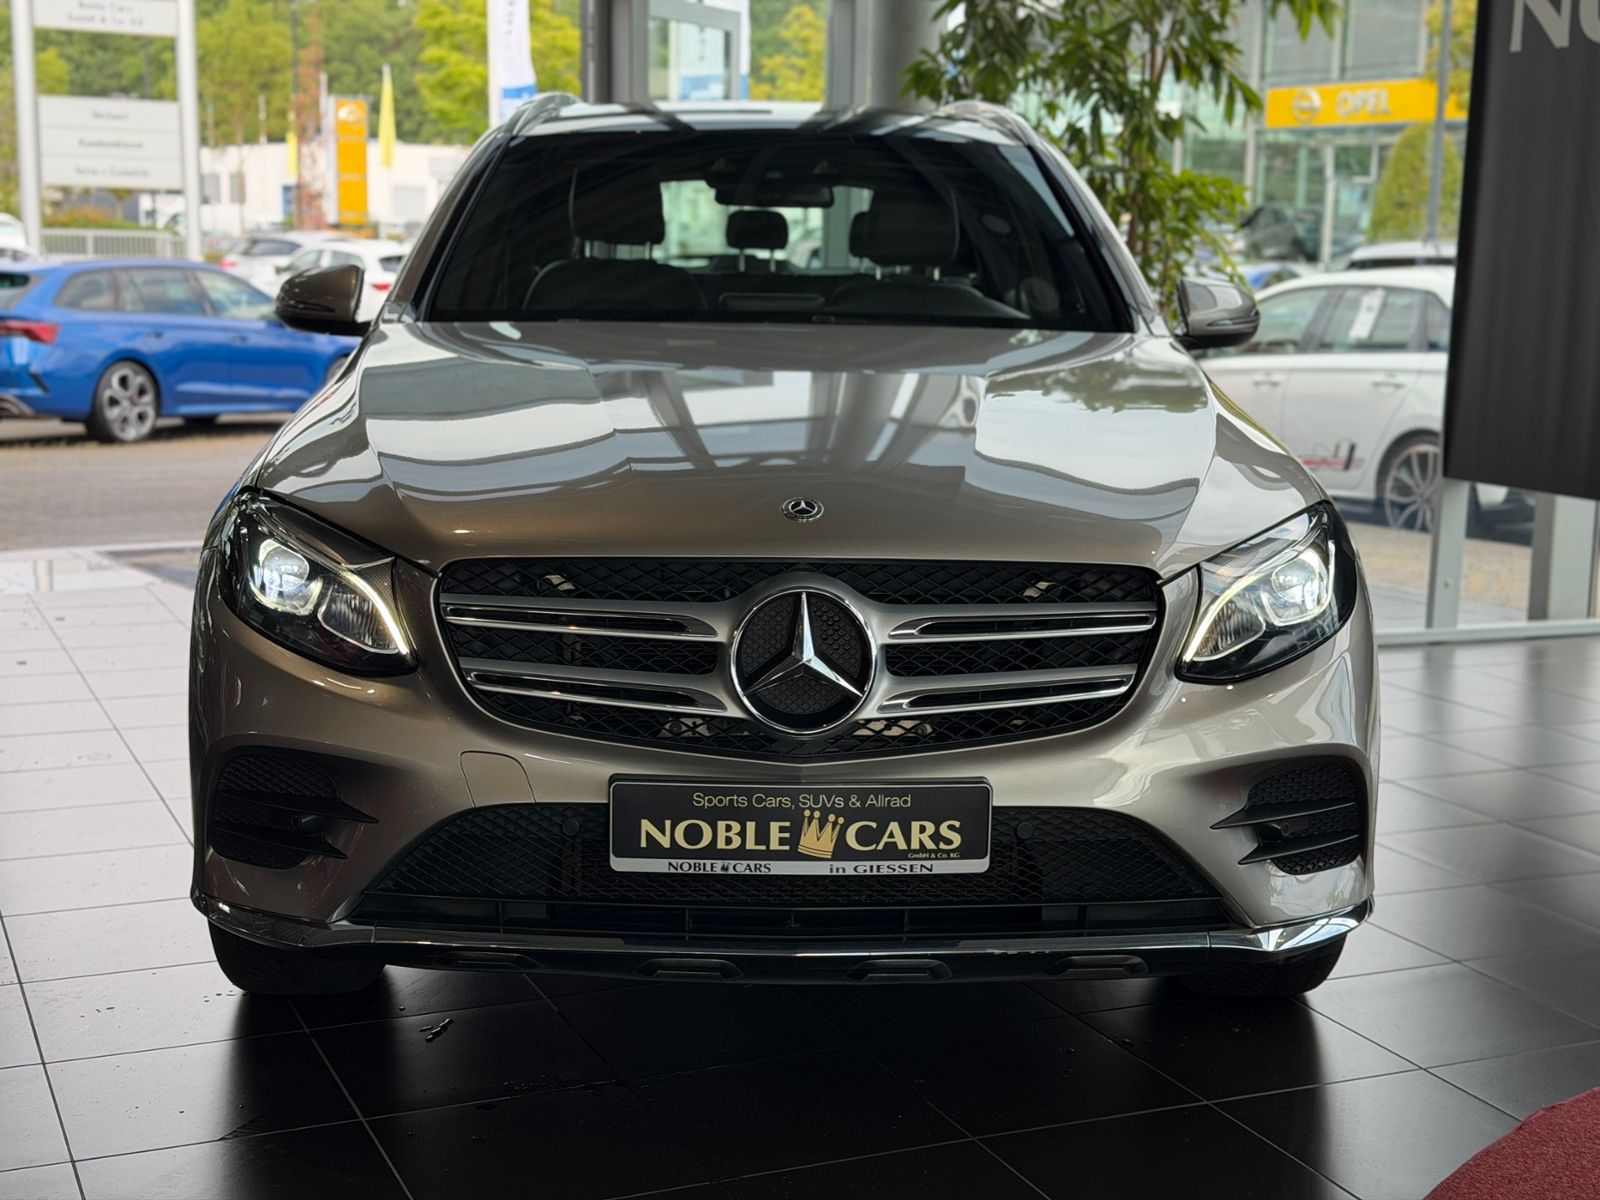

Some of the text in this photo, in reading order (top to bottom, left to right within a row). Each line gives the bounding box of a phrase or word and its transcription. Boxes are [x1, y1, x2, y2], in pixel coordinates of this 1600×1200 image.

[1509, 0, 1600, 53] N
[692, 792, 912, 810] Sports Cars, SUVs & Allrad
[640, 818, 962, 851] NOBLE CARS
[667, 861, 772, 874] NOBLE CARS
[829, 863, 934, 874] in GIESSEN
